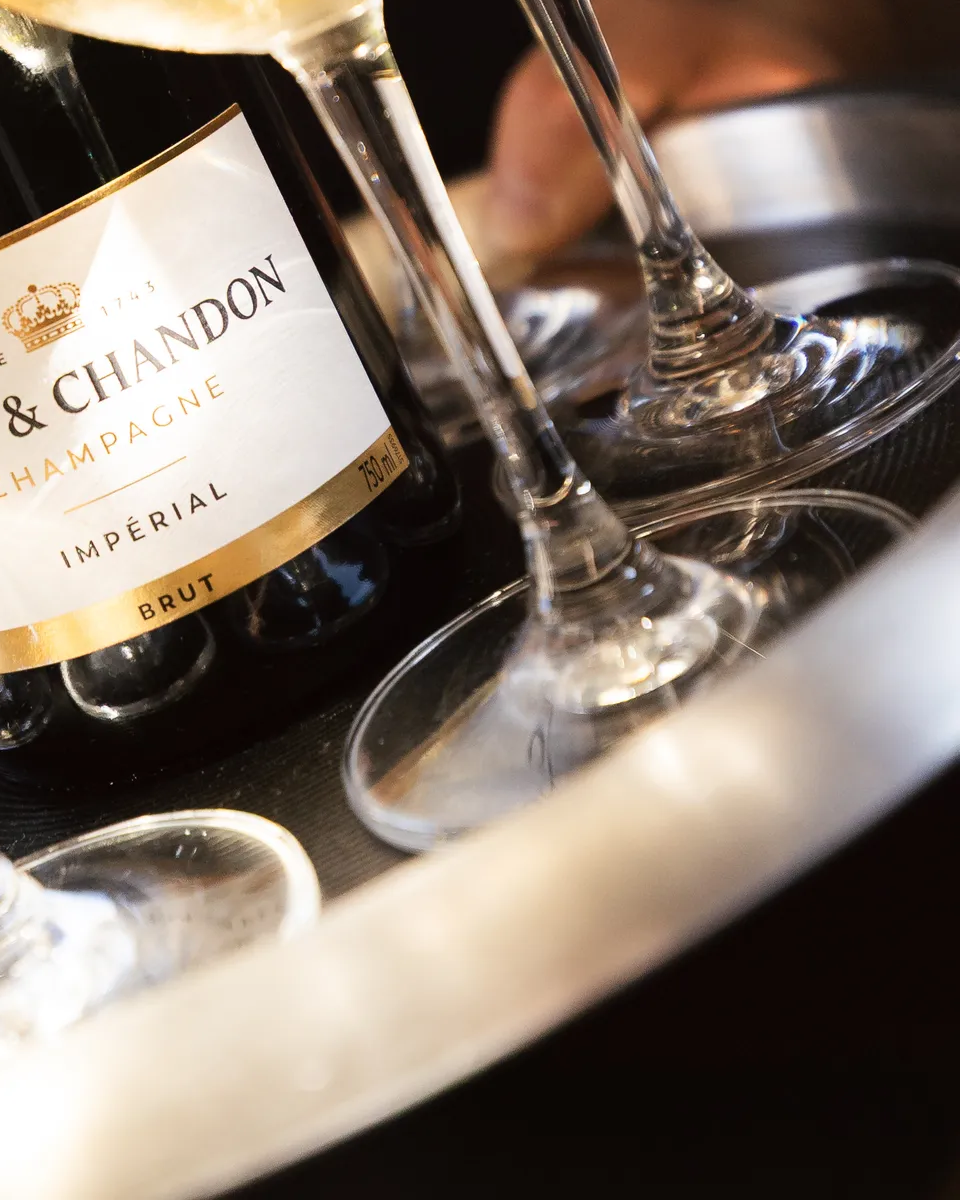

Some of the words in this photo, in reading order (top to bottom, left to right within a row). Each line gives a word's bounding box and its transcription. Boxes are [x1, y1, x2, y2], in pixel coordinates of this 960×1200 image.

[3, 395, 48, 438] &
[52, 254, 286, 414] CHANDON
[358, 455, 384, 492] 750
[381, 442, 397, 476] ml
[60, 483, 228, 569] IMPÉRIAL
[138, 573, 214, 620] BRUT
